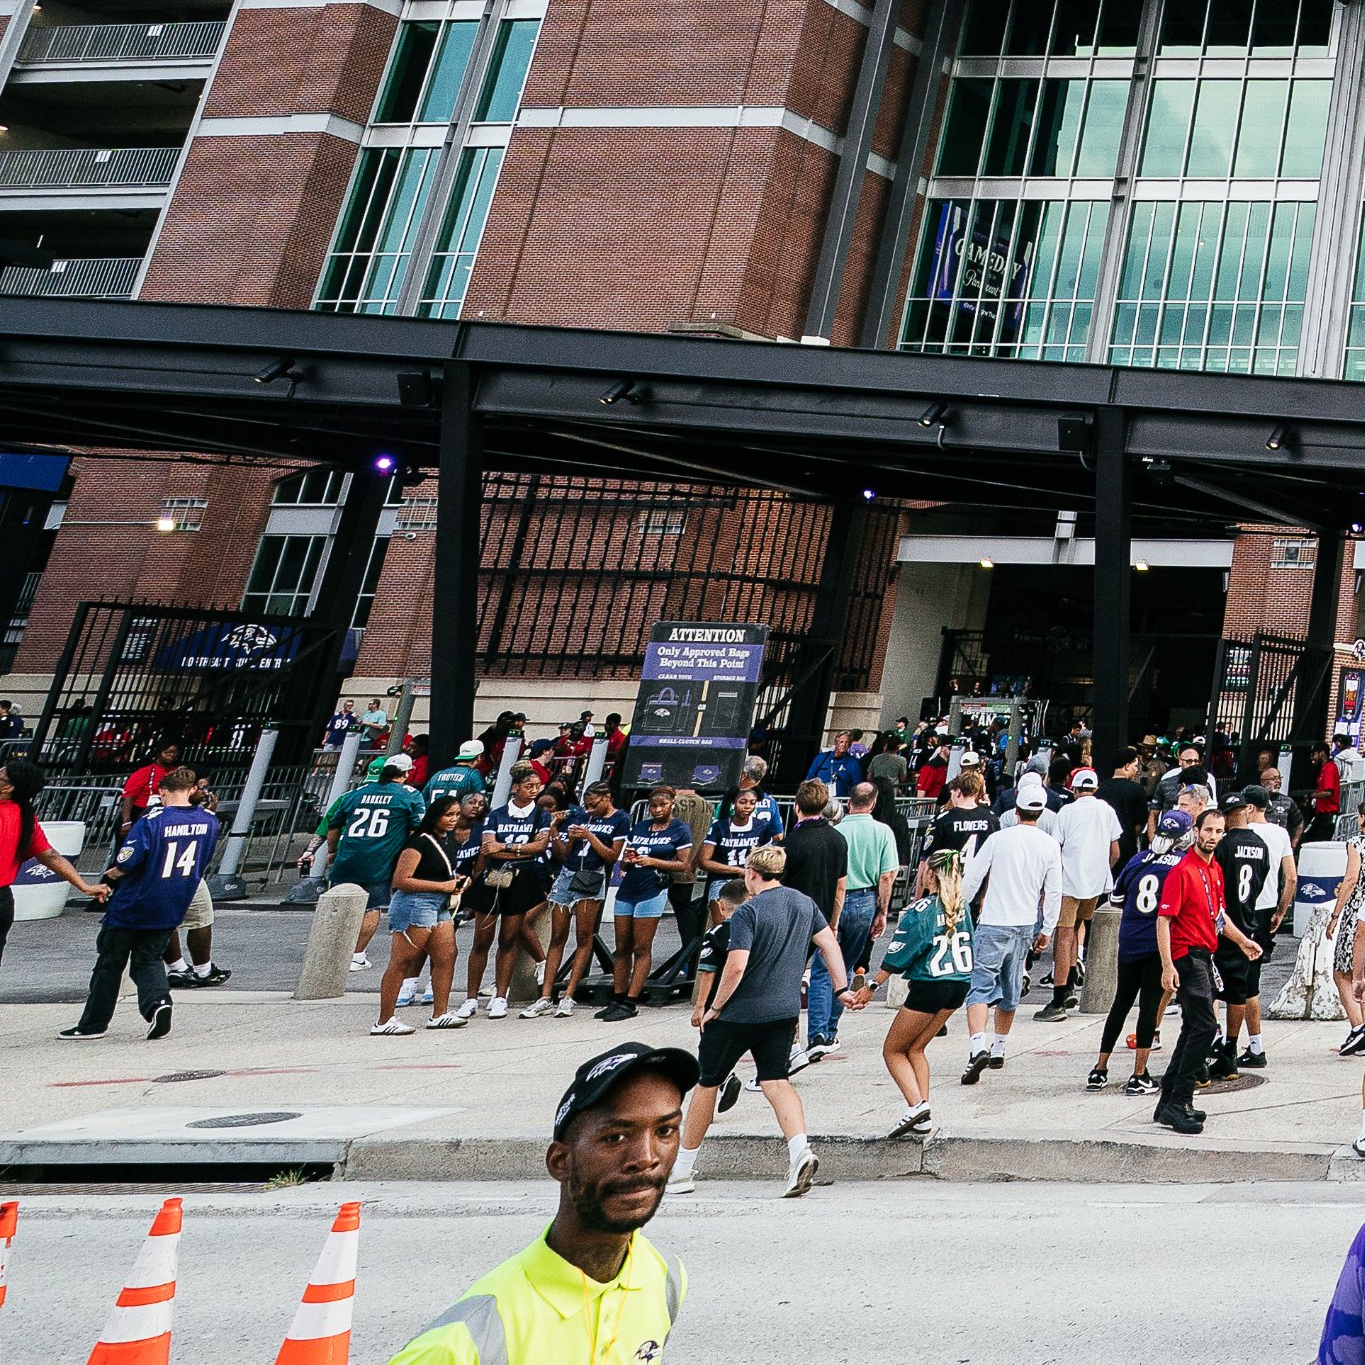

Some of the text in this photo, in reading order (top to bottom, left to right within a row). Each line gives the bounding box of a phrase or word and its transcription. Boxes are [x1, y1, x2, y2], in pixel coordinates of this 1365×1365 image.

[668, 628, 746, 643] ATTENTION
[657, 646, 751, 659] Only Approved Bags
[659, 657, 745, 669] Beyond This Point
[361, 795, 394, 805] BARKLEY
[163, 823, 209, 838] HAMILTON
[348, 808, 392, 838] 26
[953, 819, 989, 832] FLOWERS
[161, 840, 198, 878] 14
[1235, 845, 1264, 860] JACKSON
[1238, 864, 1253, 903] 8
[1136, 874, 1160, 914] 8
[930, 931, 975, 978] 26
